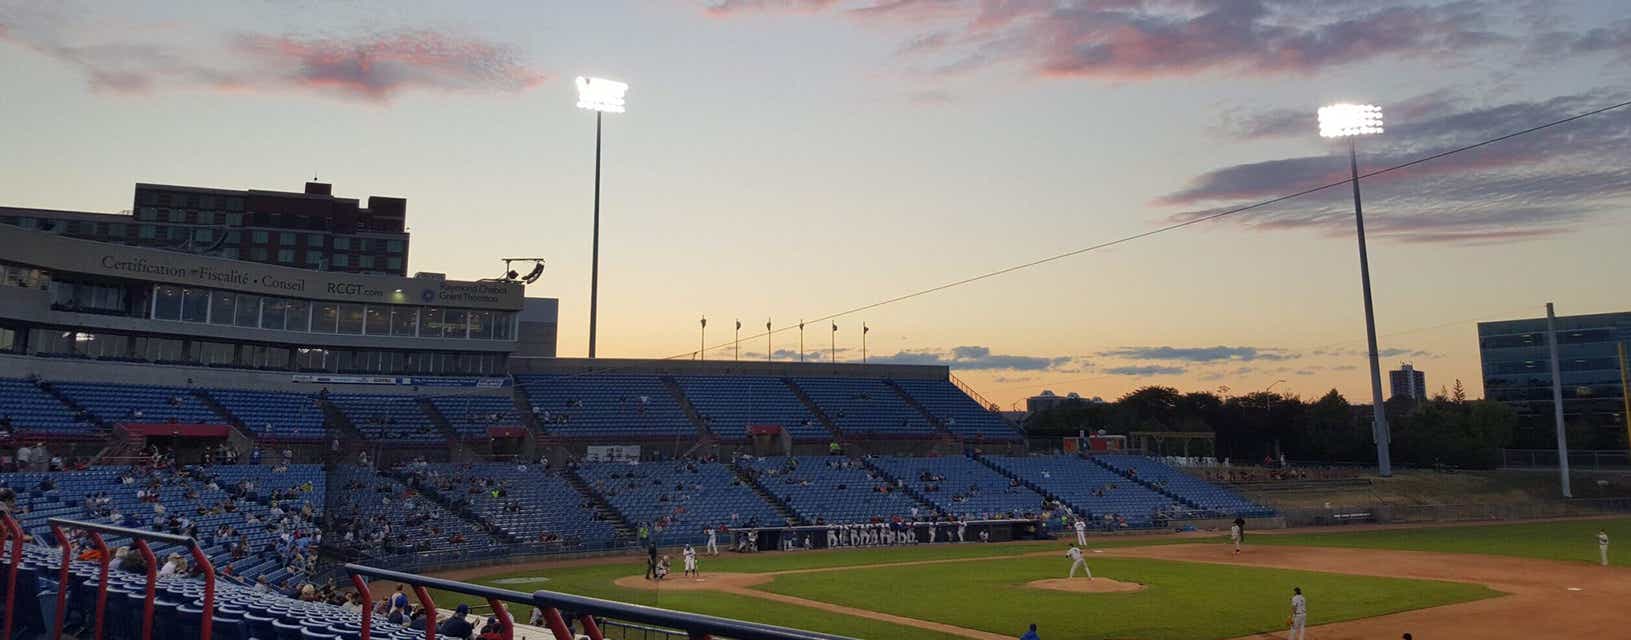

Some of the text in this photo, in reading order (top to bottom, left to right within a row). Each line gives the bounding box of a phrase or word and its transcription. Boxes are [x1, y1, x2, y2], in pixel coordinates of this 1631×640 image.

[102, 255, 305, 291] Certification Fiscalité Conseil
[327, 282, 384, 297] RCGT.com
